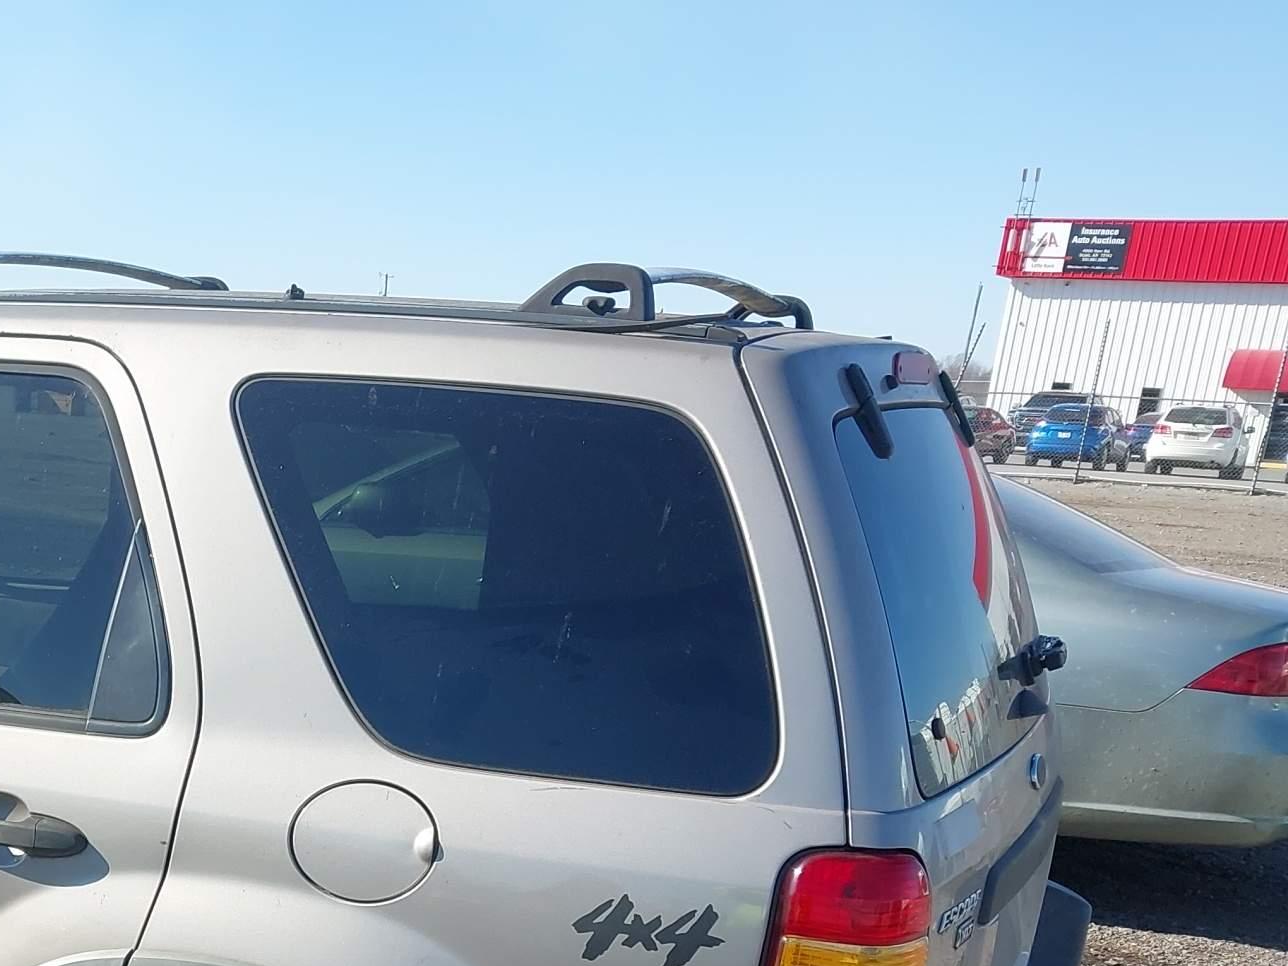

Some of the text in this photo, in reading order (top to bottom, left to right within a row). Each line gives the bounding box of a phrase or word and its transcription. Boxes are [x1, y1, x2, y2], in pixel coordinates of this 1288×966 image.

[1080, 227, 1120, 236] Insurance
[1071, 235, 1126, 245] Auto Auctions
